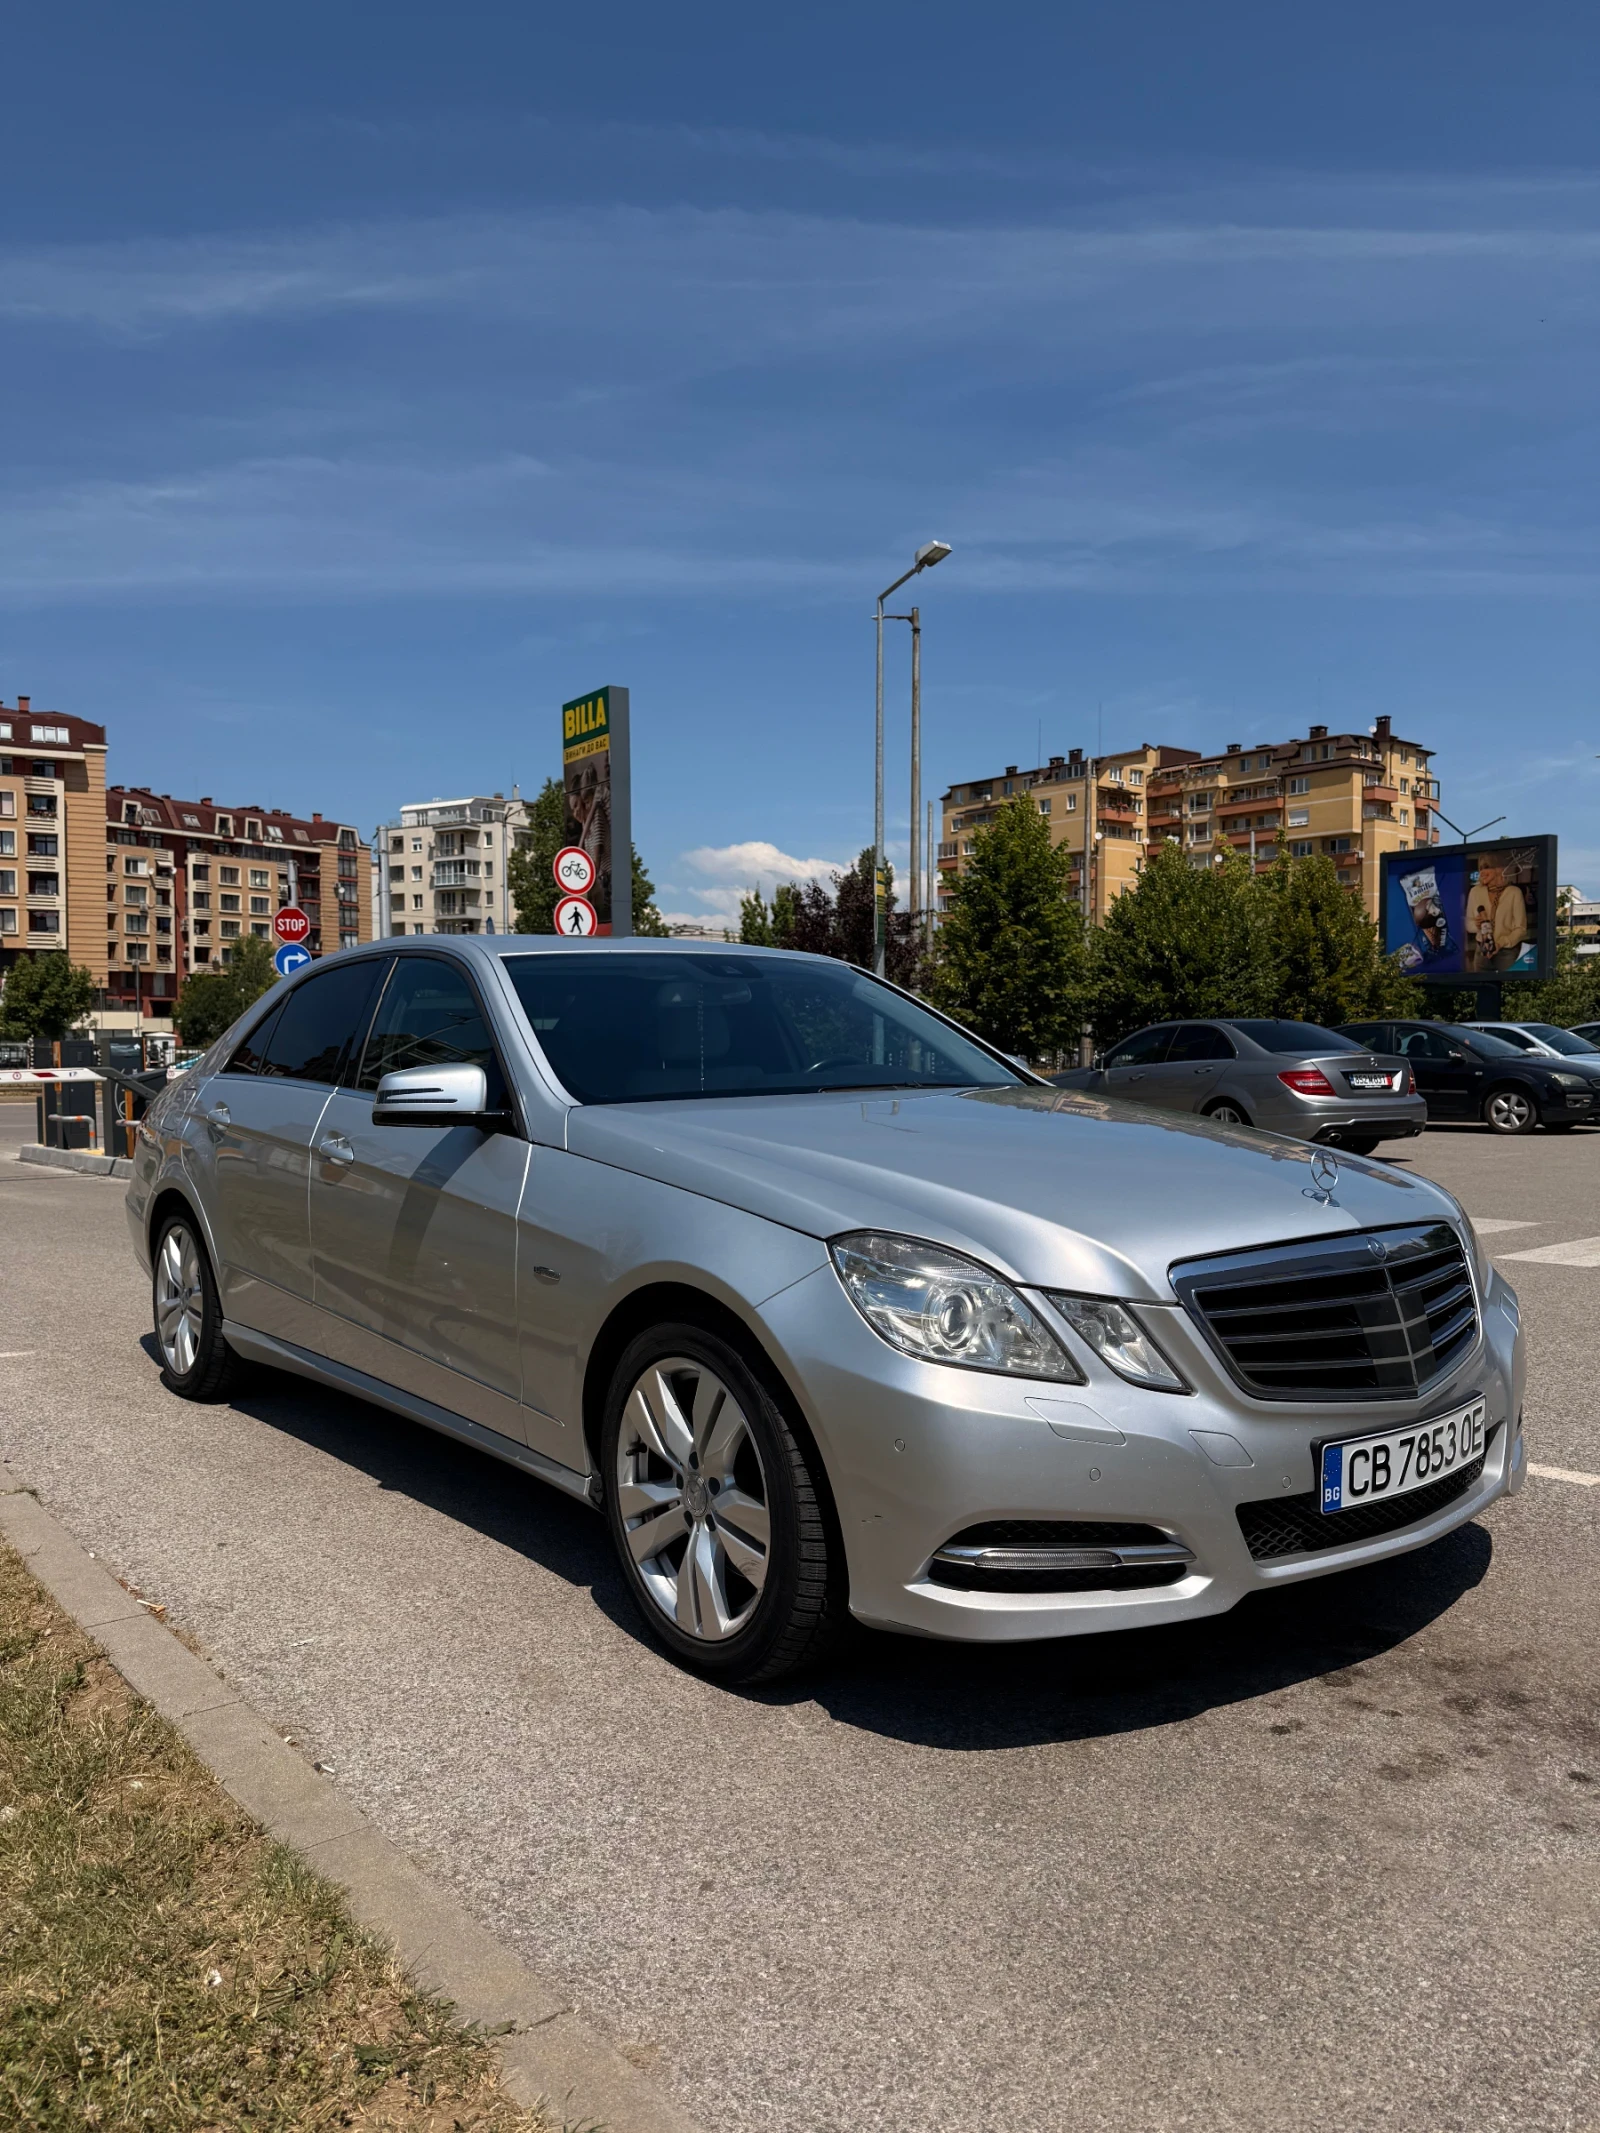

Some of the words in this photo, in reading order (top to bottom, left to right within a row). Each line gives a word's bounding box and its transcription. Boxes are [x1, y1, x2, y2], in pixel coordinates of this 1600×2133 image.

[565, 697, 606, 739] BILLA
[565, 746, 586, 761] ВИНАГИ
[587, 742, 595, 753] ДО
[595, 738, 607, 750] ВАС
[277, 918, 306, 932] STOP
[1348, 1443, 1391, 1497] CB
[1397, 1420, 1458, 1488] 7853
[1460, 1404, 1484, 1459] OE
[1324, 1486, 1341, 1503] BG
